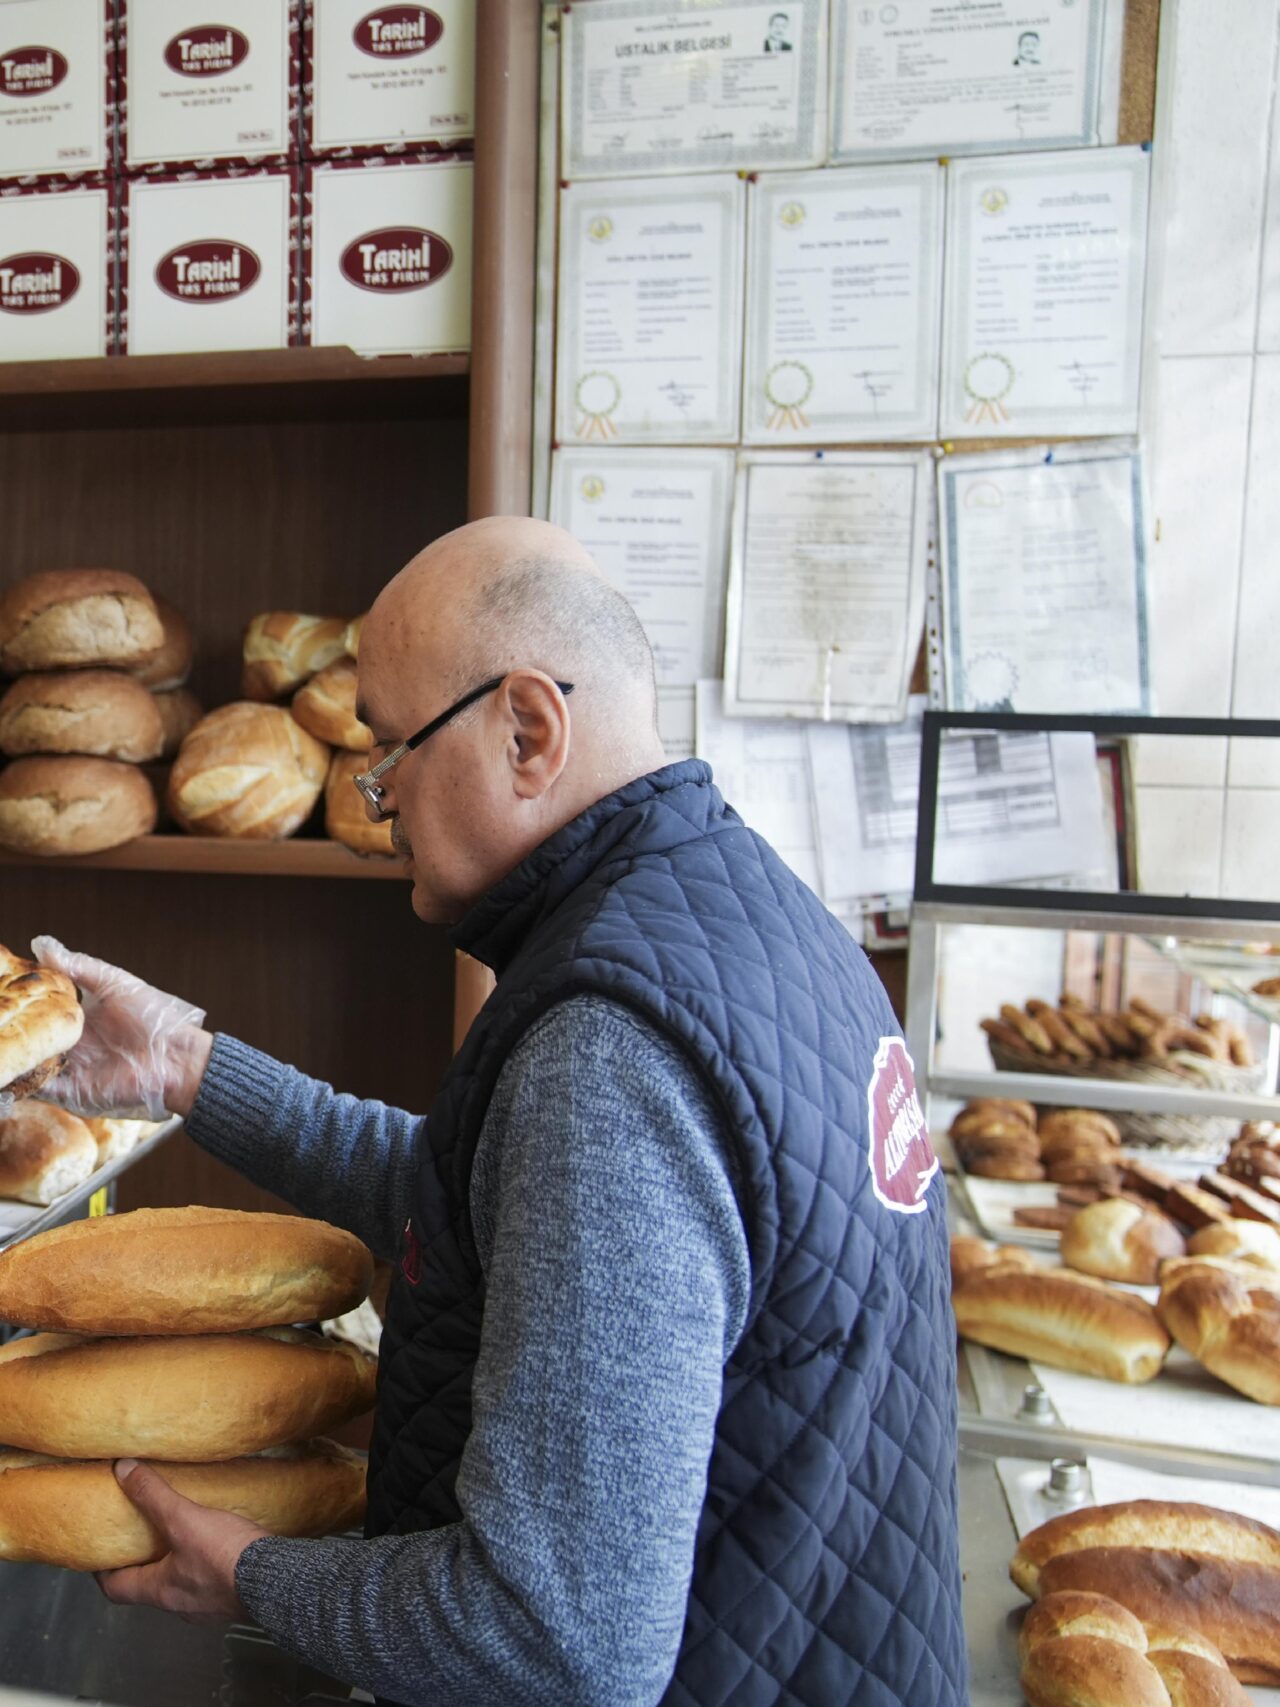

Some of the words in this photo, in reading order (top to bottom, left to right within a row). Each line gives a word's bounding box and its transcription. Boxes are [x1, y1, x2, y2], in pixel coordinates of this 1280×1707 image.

[368, 11, 426, 41] TARİHİ
[615, 38, 671, 58] USTALIK
[172, 247, 241, 282] TARİHİ
[358, 234, 430, 272] TARİHİ
